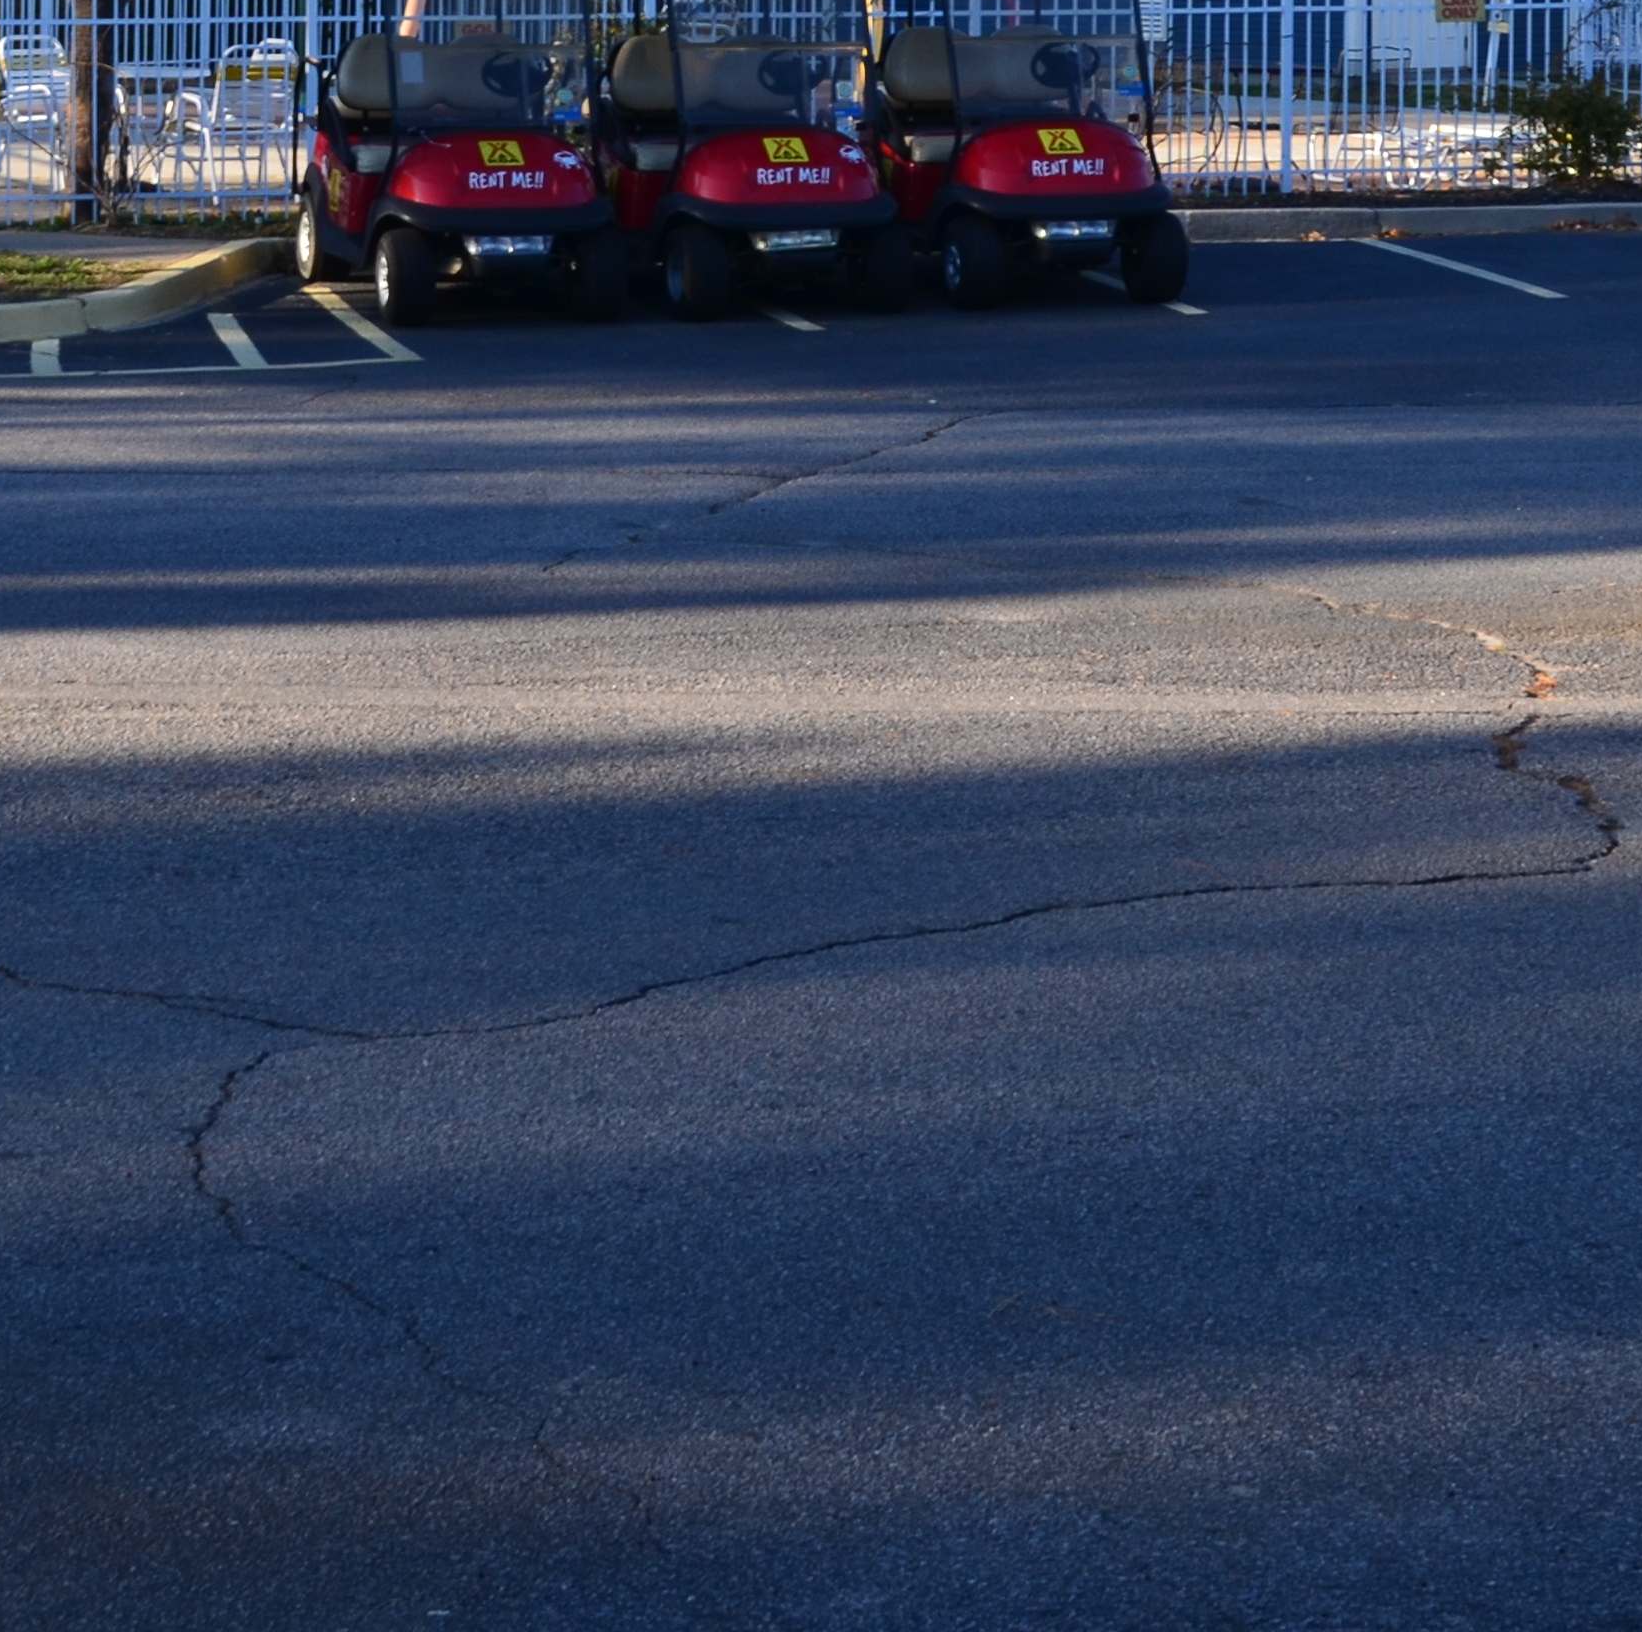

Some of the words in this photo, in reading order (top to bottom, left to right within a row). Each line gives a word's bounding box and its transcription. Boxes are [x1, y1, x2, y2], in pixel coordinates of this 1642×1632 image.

[1442, 7, 1478, 19] ONLY
[757, 167, 794, 185] RENT
[799, 167, 830, 185] ME!!
[1031, 159, 1068, 177] RENT
[1072, 158, 1104, 176] ME!!
[468, 171, 507, 189] RENT
[511, 171, 544, 189] ME!!
